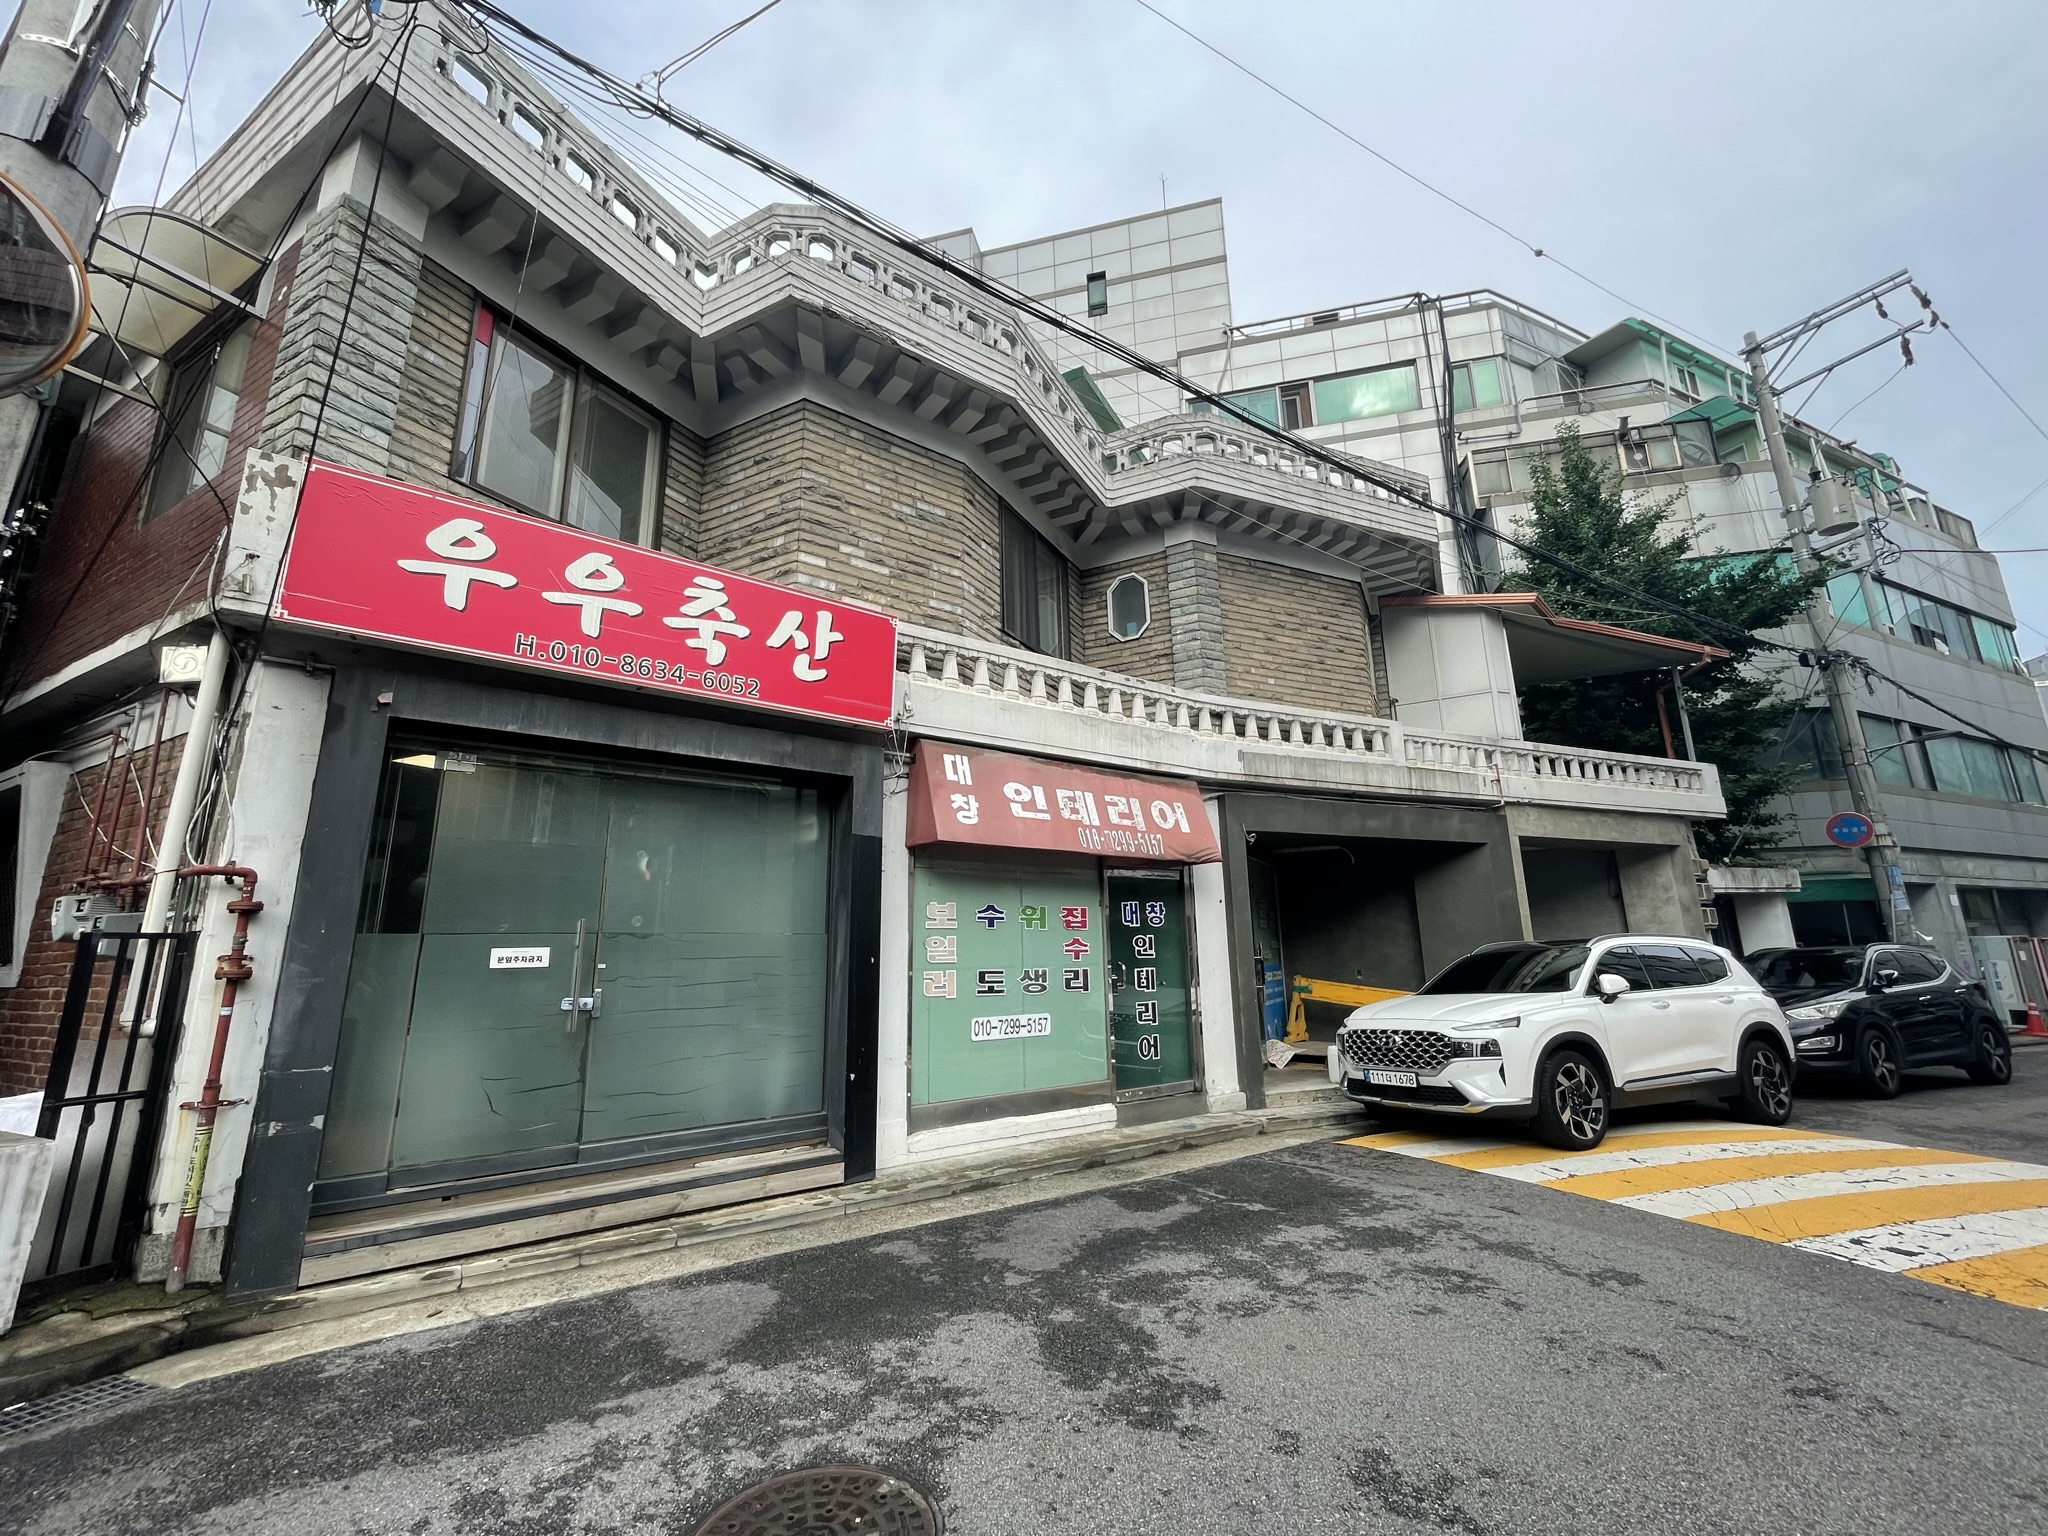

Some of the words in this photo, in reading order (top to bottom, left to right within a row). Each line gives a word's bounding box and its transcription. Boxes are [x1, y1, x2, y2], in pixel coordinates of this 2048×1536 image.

[397, 517, 844, 683] 우우축산
[514, 633, 761, 697] H.010-8634-6052
[943, 753, 979, 825] 대창
[1002, 781, 1191, 833] 인테리어
[1059, 906, 1091, 993] 집수리
[1121, 901, 1166, 927] 대창
[923, 902, 957, 999] 보일러
[973, 1017, 1048, 1038] 010-7299-5157
[1132, 934, 1160, 1061] 인테리어
